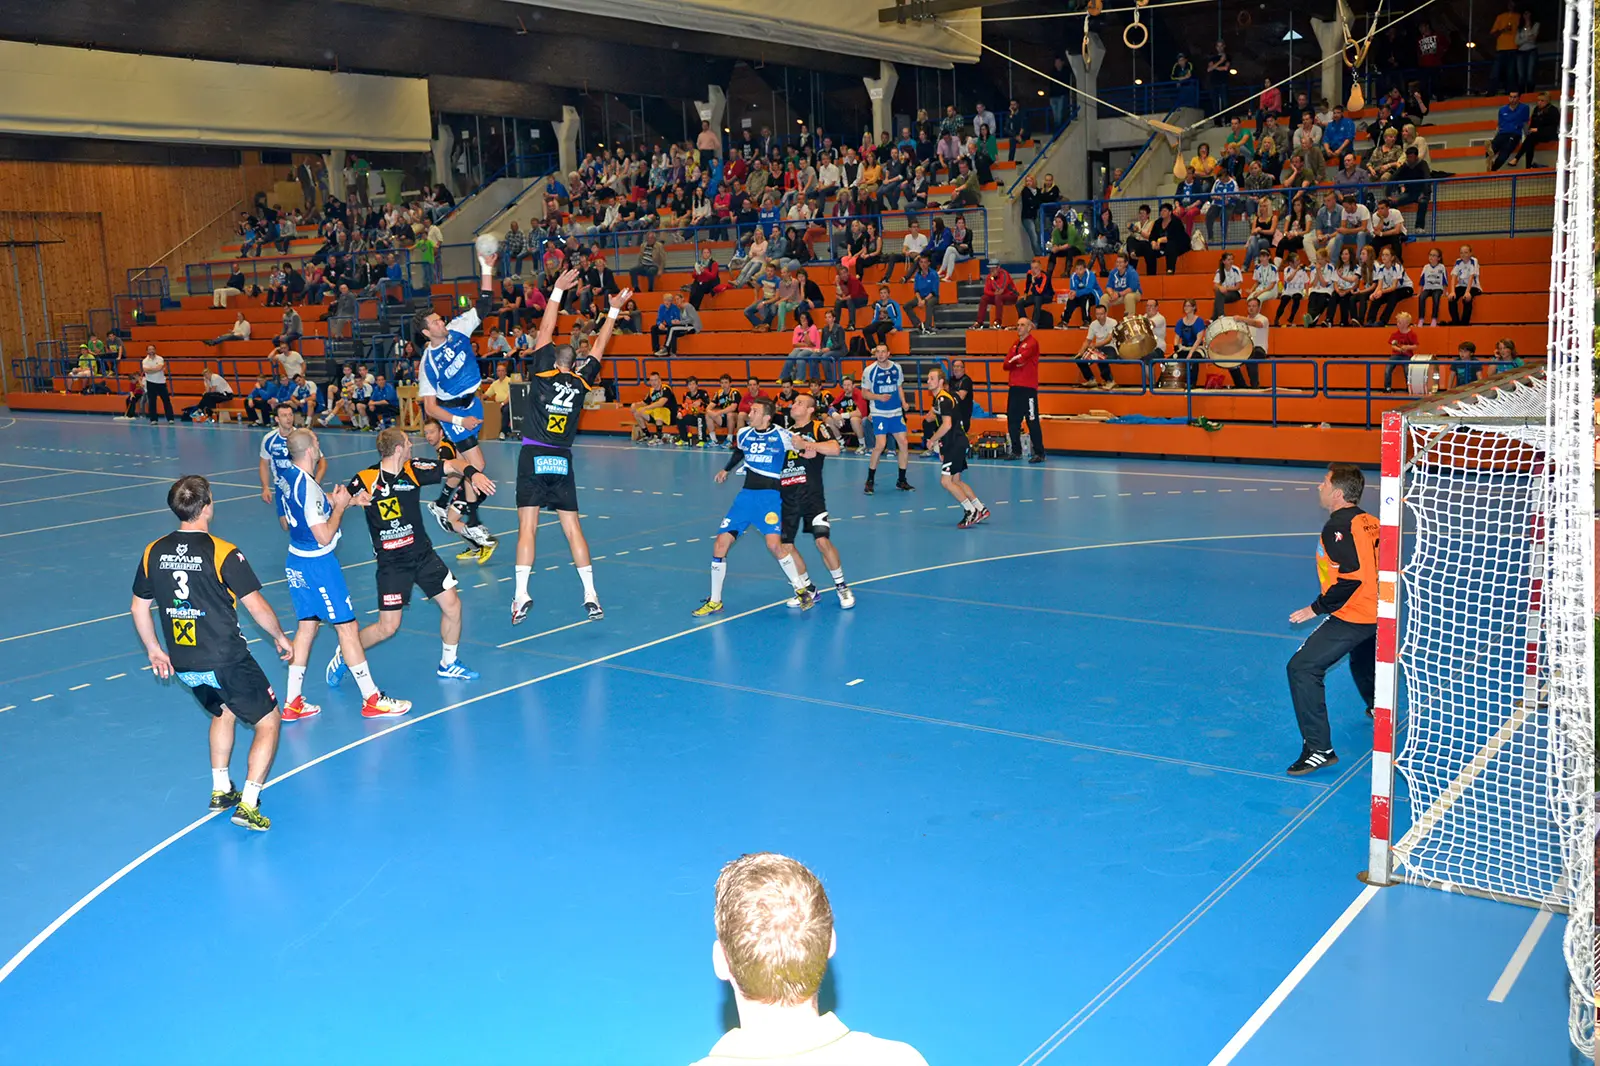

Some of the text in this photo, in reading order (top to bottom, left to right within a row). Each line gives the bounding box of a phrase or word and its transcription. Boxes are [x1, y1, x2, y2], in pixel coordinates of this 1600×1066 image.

[444, 347, 455, 362] 18
[885, 375, 892, 384] 4
[551, 387, 574, 408] 22
[878, 421, 884, 431] 4
[282, 447, 289, 457] 9
[749, 442, 767, 453] 85
[536, 458, 567, 467] GAEDKE
[379, 523, 413, 536] REMUS
[159, 554, 203, 564] REMUS
[172, 570, 190, 600] 3
